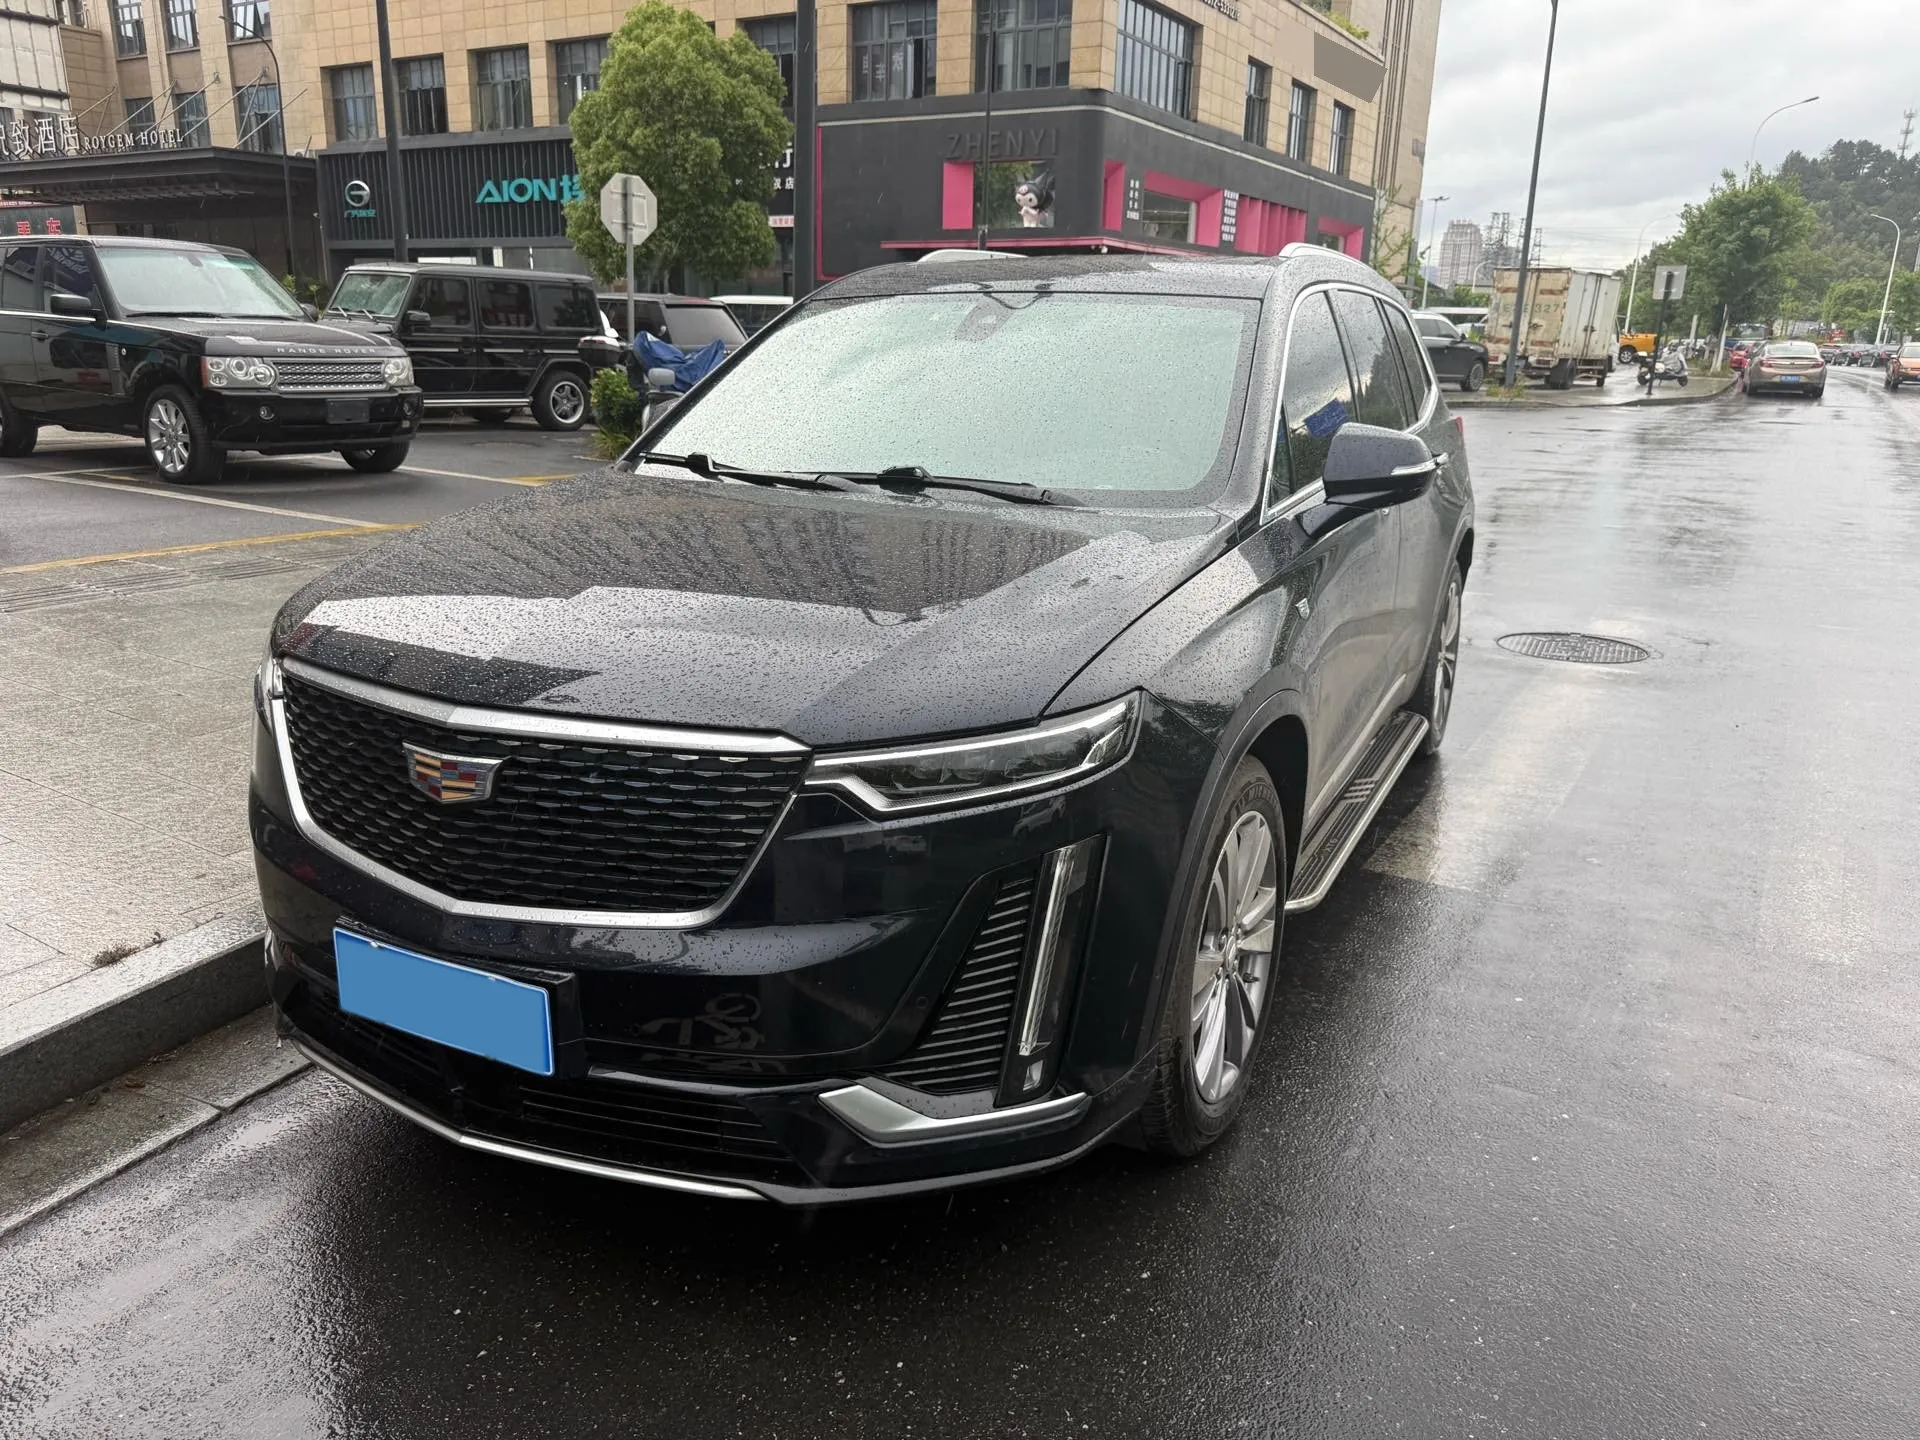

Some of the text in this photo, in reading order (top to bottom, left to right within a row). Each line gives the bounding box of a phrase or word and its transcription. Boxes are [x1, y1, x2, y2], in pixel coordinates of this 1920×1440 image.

[84, 128, 183, 150] ROYGEM HOTEL
[944, 129, 1058, 158] ZHENYI
[475, 178, 557, 203] AION
